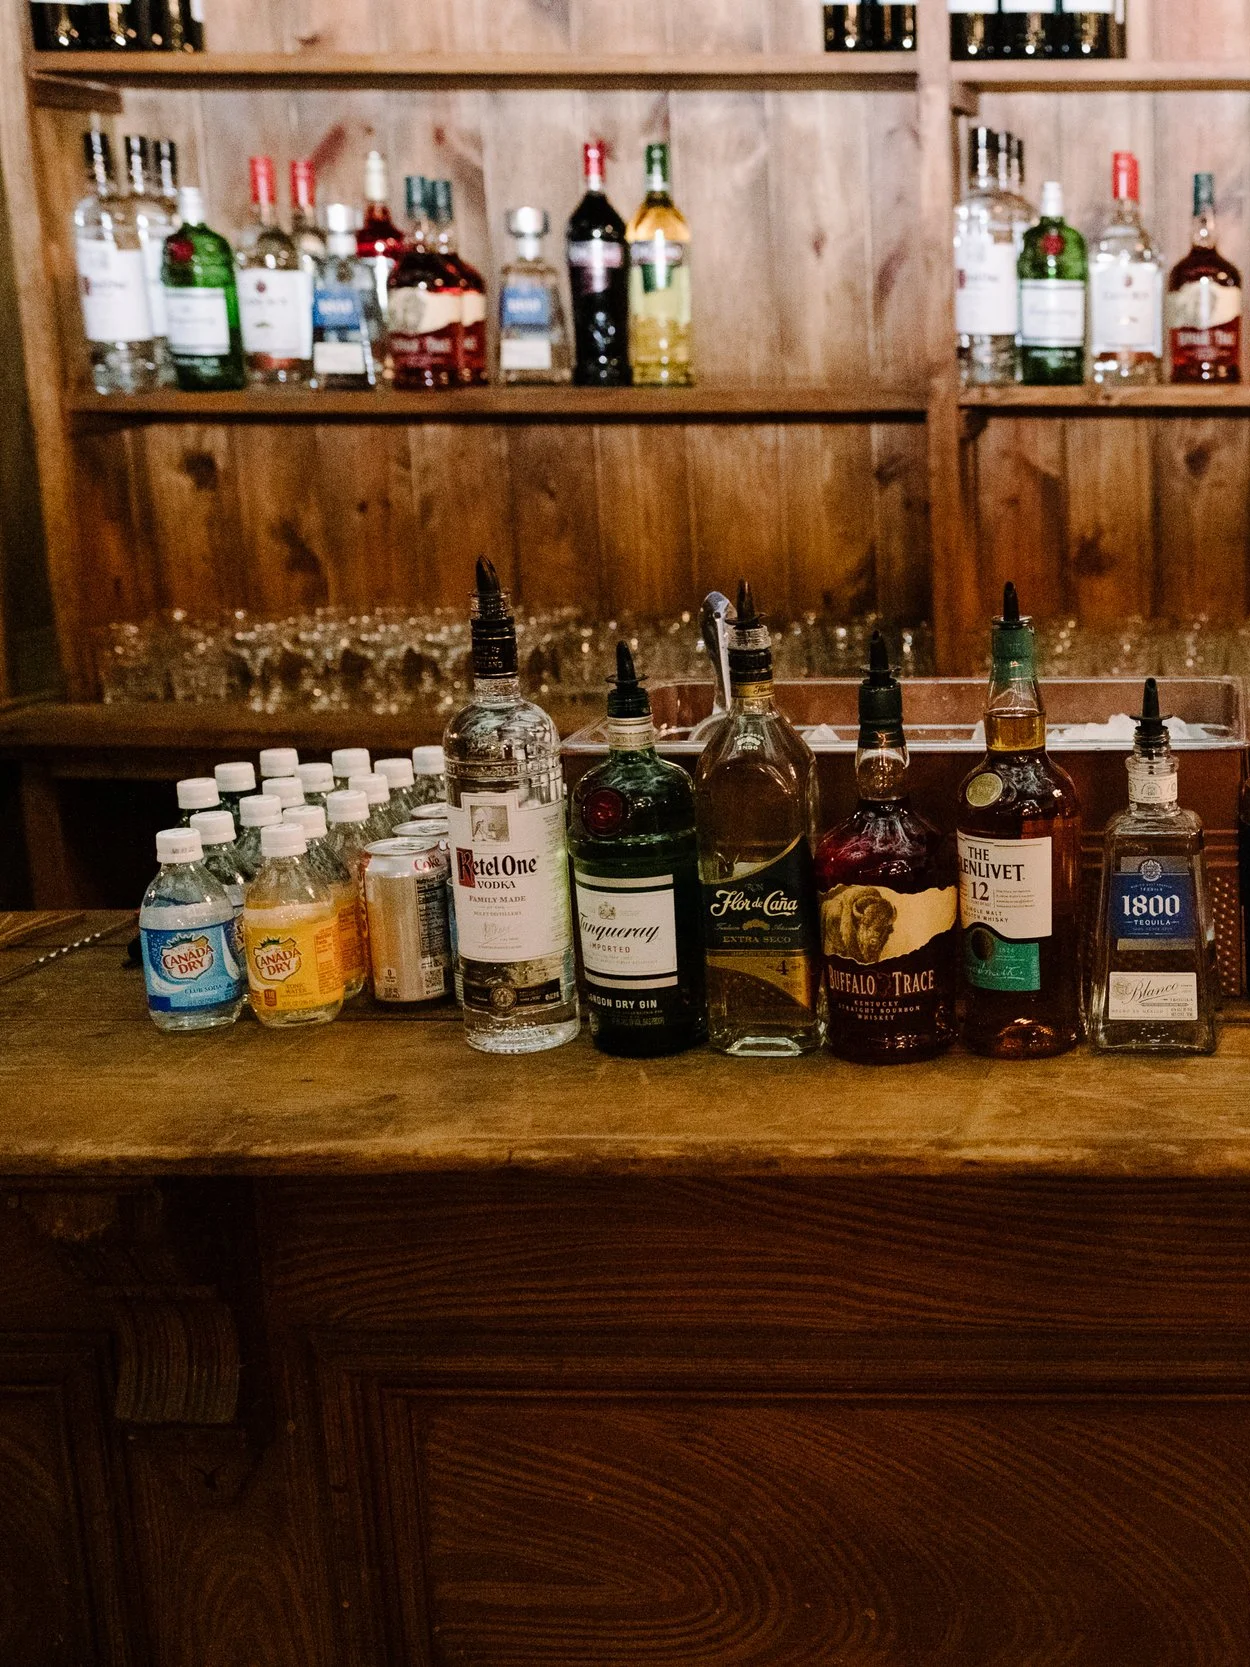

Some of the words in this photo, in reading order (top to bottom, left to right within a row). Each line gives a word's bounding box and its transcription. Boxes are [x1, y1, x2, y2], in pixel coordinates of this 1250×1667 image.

[967, 846, 990, 861] THE
[413, 854, 441, 871] Coke
[459, 850, 500, 881] Ketel
[501, 854, 537, 877] One
[476, 880, 517, 890] VODKA
[970, 881, 990, 901] 12
[469, 895, 498, 904] FAMILY
[499, 895, 526, 903] MADE
[710, 889, 751, 917] Flor
[751, 896, 763, 908] de
[763, 889, 799, 917] Caña
[1121, 894, 1180, 917] 1800
[983, 915, 1009, 923] WHISKY
[580, 911, 660, 944] Tanqueray
[723, 935, 760, 943] EXTRA
[763, 935, 792, 943] SECO
[589, 943, 631, 954] IMPORTED
[162, 944, 214, 970] CANADA
[255, 947, 302, 970] CANADA
[178, 958, 204, 975] DRY
[267, 960, 292, 976] DRY
[776, 960, 790, 976] 4
[828, 963, 876, 996] BUFFALO
[892, 969, 936, 996] TRACE
[204, 984, 223, 992] SODA
[1122, 979, 1178, 1004] Blanco
[615, 999, 635, 1009] DRY
[639, 999, 658, 1009] GIN
[880, 1005, 920, 1014] BOURBON
[857, 1013, 895, 1021] WHISKEY
